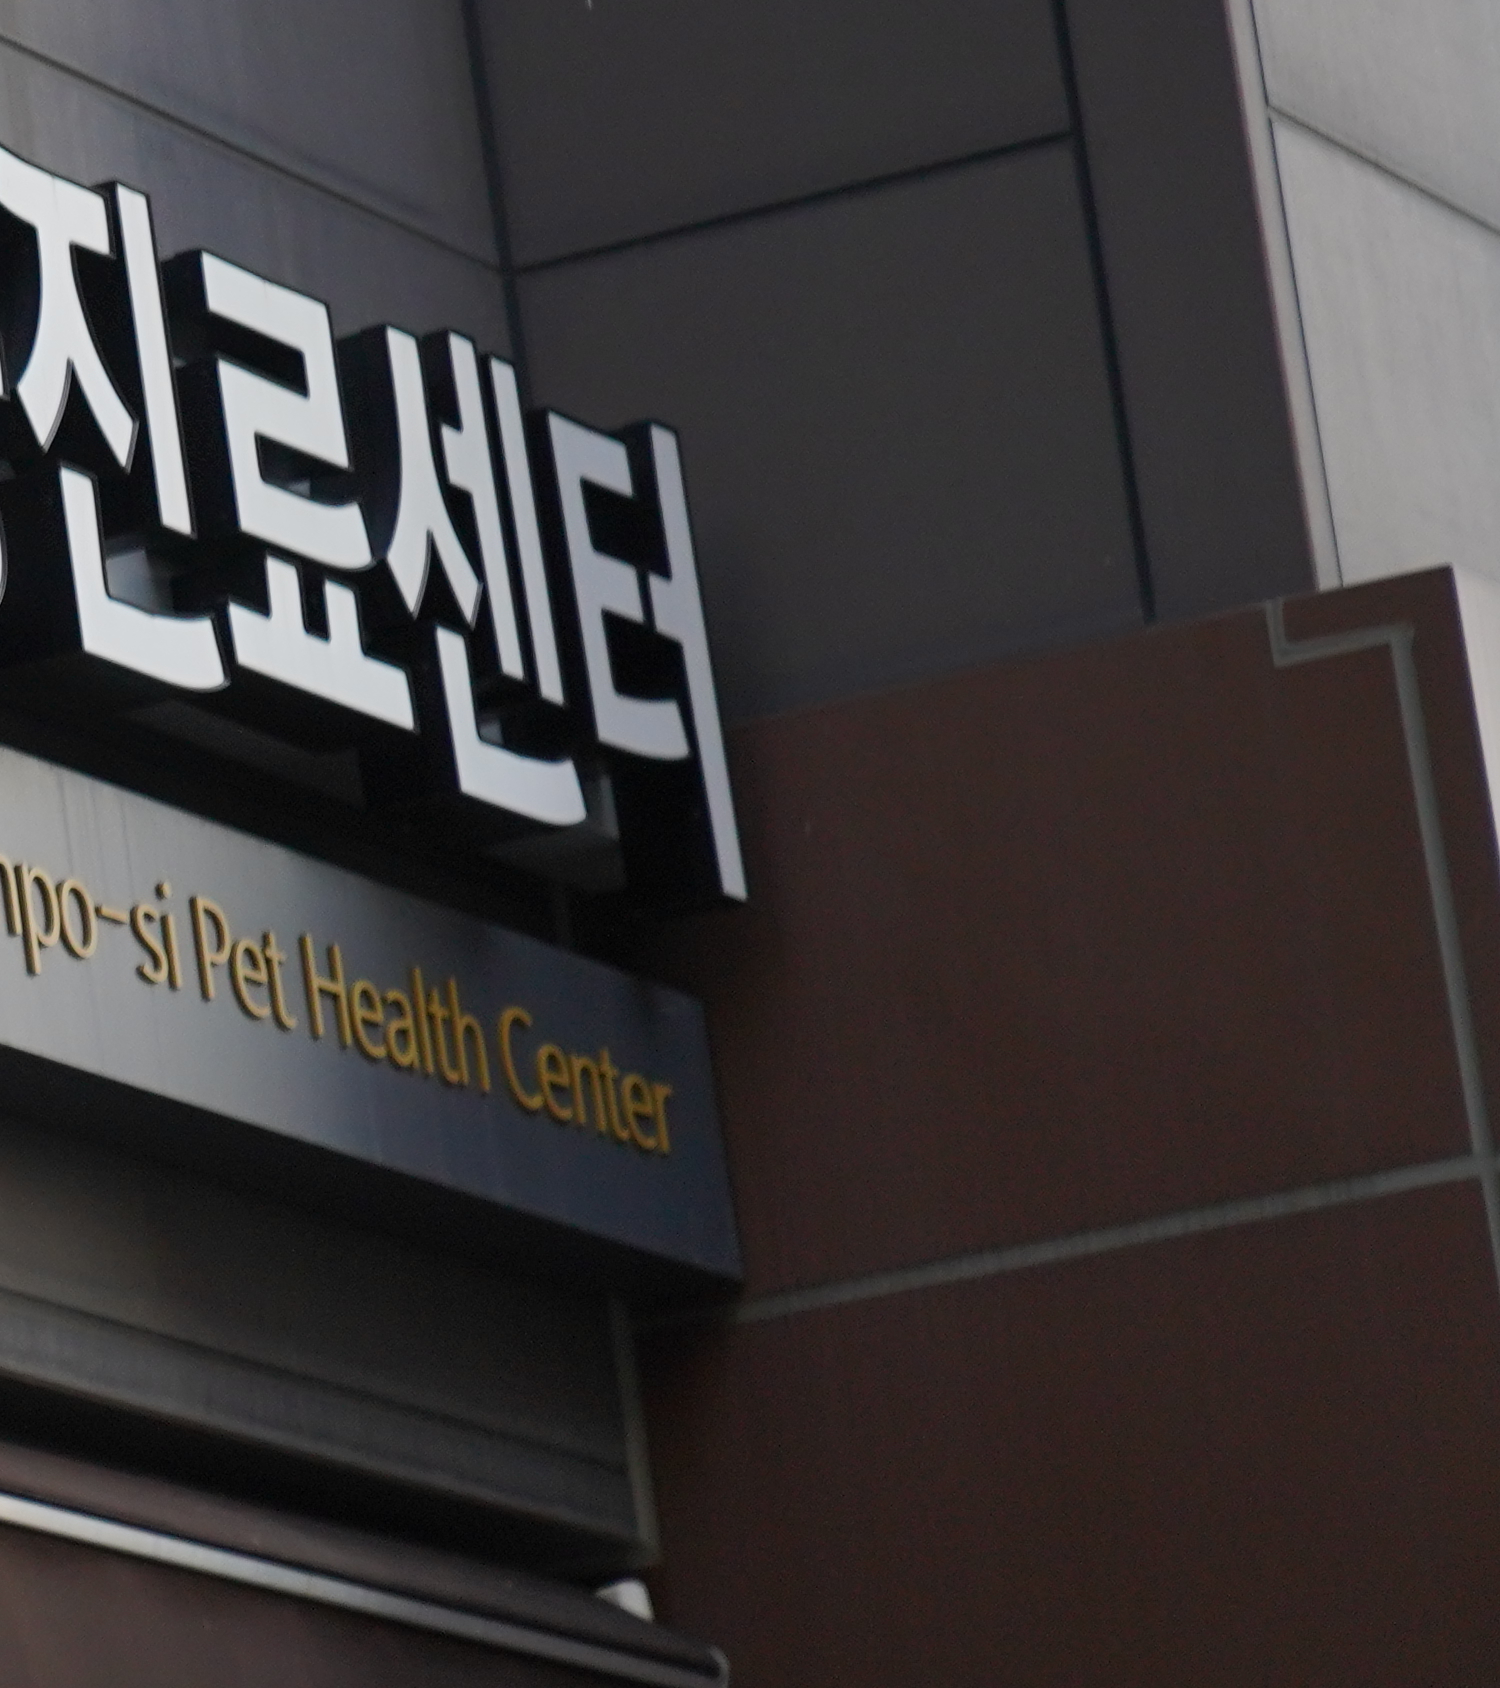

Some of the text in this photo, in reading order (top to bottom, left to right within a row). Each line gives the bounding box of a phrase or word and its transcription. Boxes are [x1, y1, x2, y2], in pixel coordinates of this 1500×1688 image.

[190, 896, 296, 1030] Pet
[300, 932, 490, 1093] Health
[500, 1006, 674, 1154] Center
